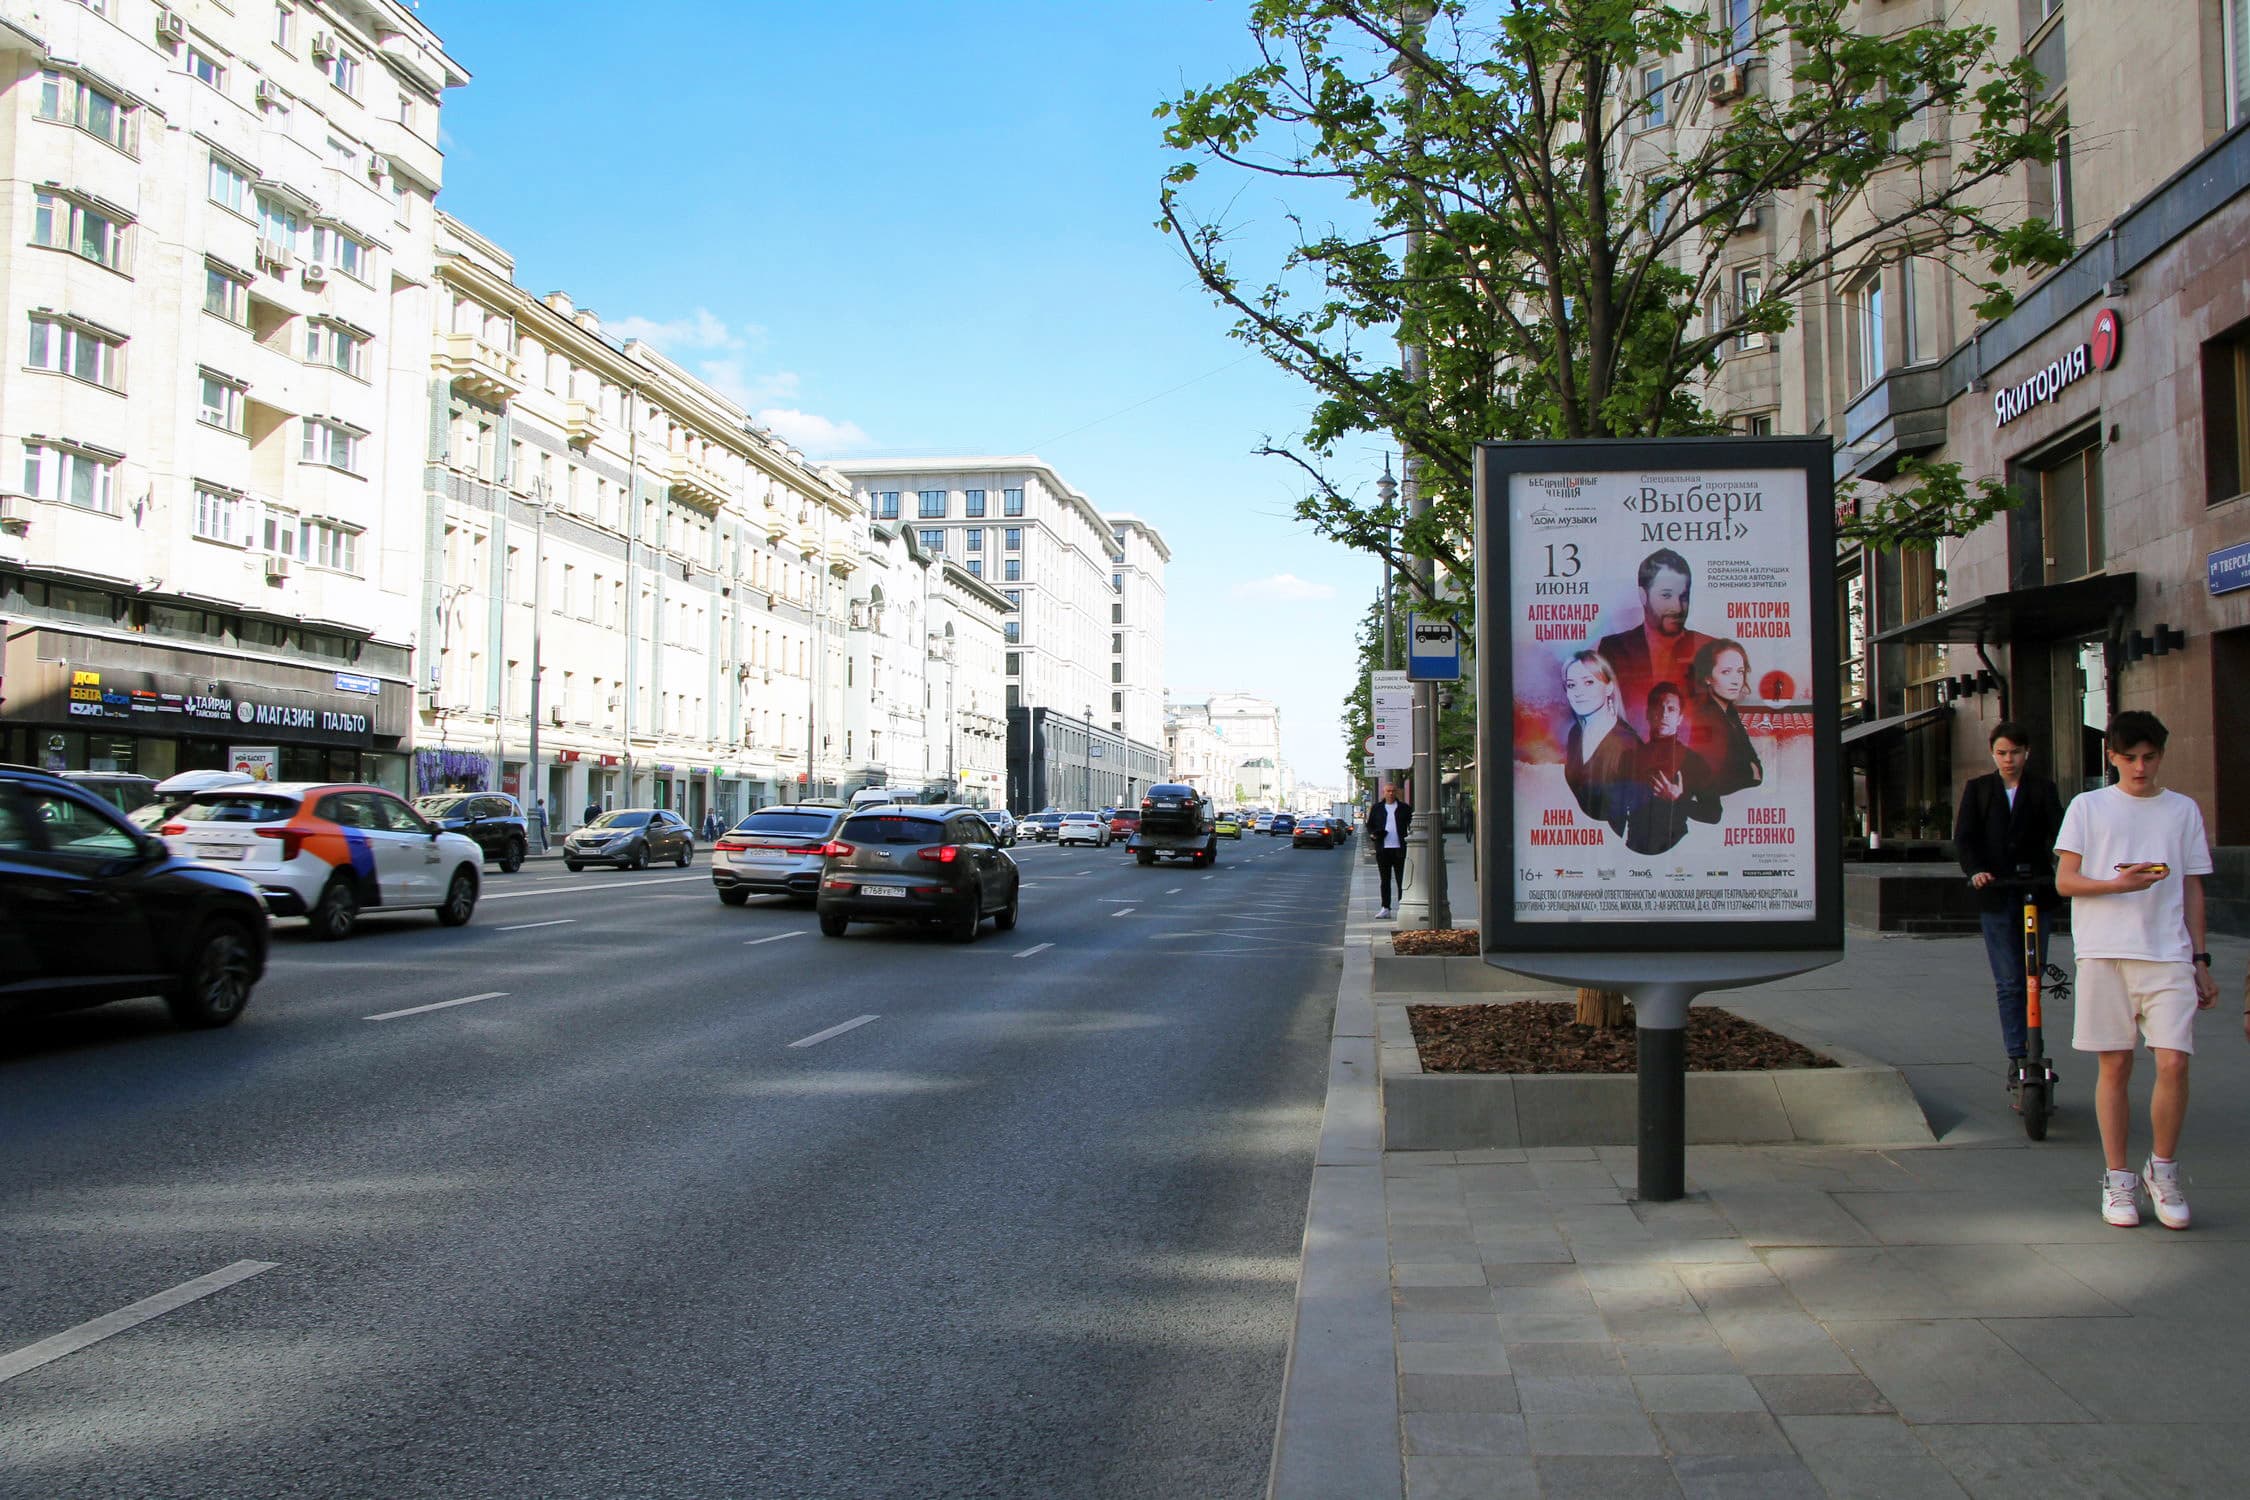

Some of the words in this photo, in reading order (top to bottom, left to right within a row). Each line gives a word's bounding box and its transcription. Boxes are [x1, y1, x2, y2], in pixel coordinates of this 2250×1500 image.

[1994, 343, 2087, 427] Якитория
[1640, 475, 1702, 484] Специальная
[1705, 481, 1759, 491] программа
[1623, 486, 1763, 520] «Выбери
[1640, 517, 1749, 542] меня!»
[1544, 543, 1582, 578] 13
[1535, 582, 1589, 595] ИЮНЯ
[1528, 604, 1599, 622] АЛЕКСАНДР
[1727, 602, 1790, 618] ВИКТОРИЯ
[1535, 624, 1587, 642] ЦЫПКИН
[1736, 621, 1791, 638] ИСАКОВА
[195, 696, 232, 712] ТАЙРАЙ
[256, 704, 315, 729] МАГАЗИН
[323, 711, 366, 733] ПАЛЬТО
[1543, 809, 1573, 826] АННА
[1748, 807, 1786, 825] ПАВЕЛ
[1530, 829, 1604, 846] МИХАЛКОВА
[1724, 827, 1795, 846] ДЕРЕВЯНКО
[1519, 868, 1543, 881] 16+
